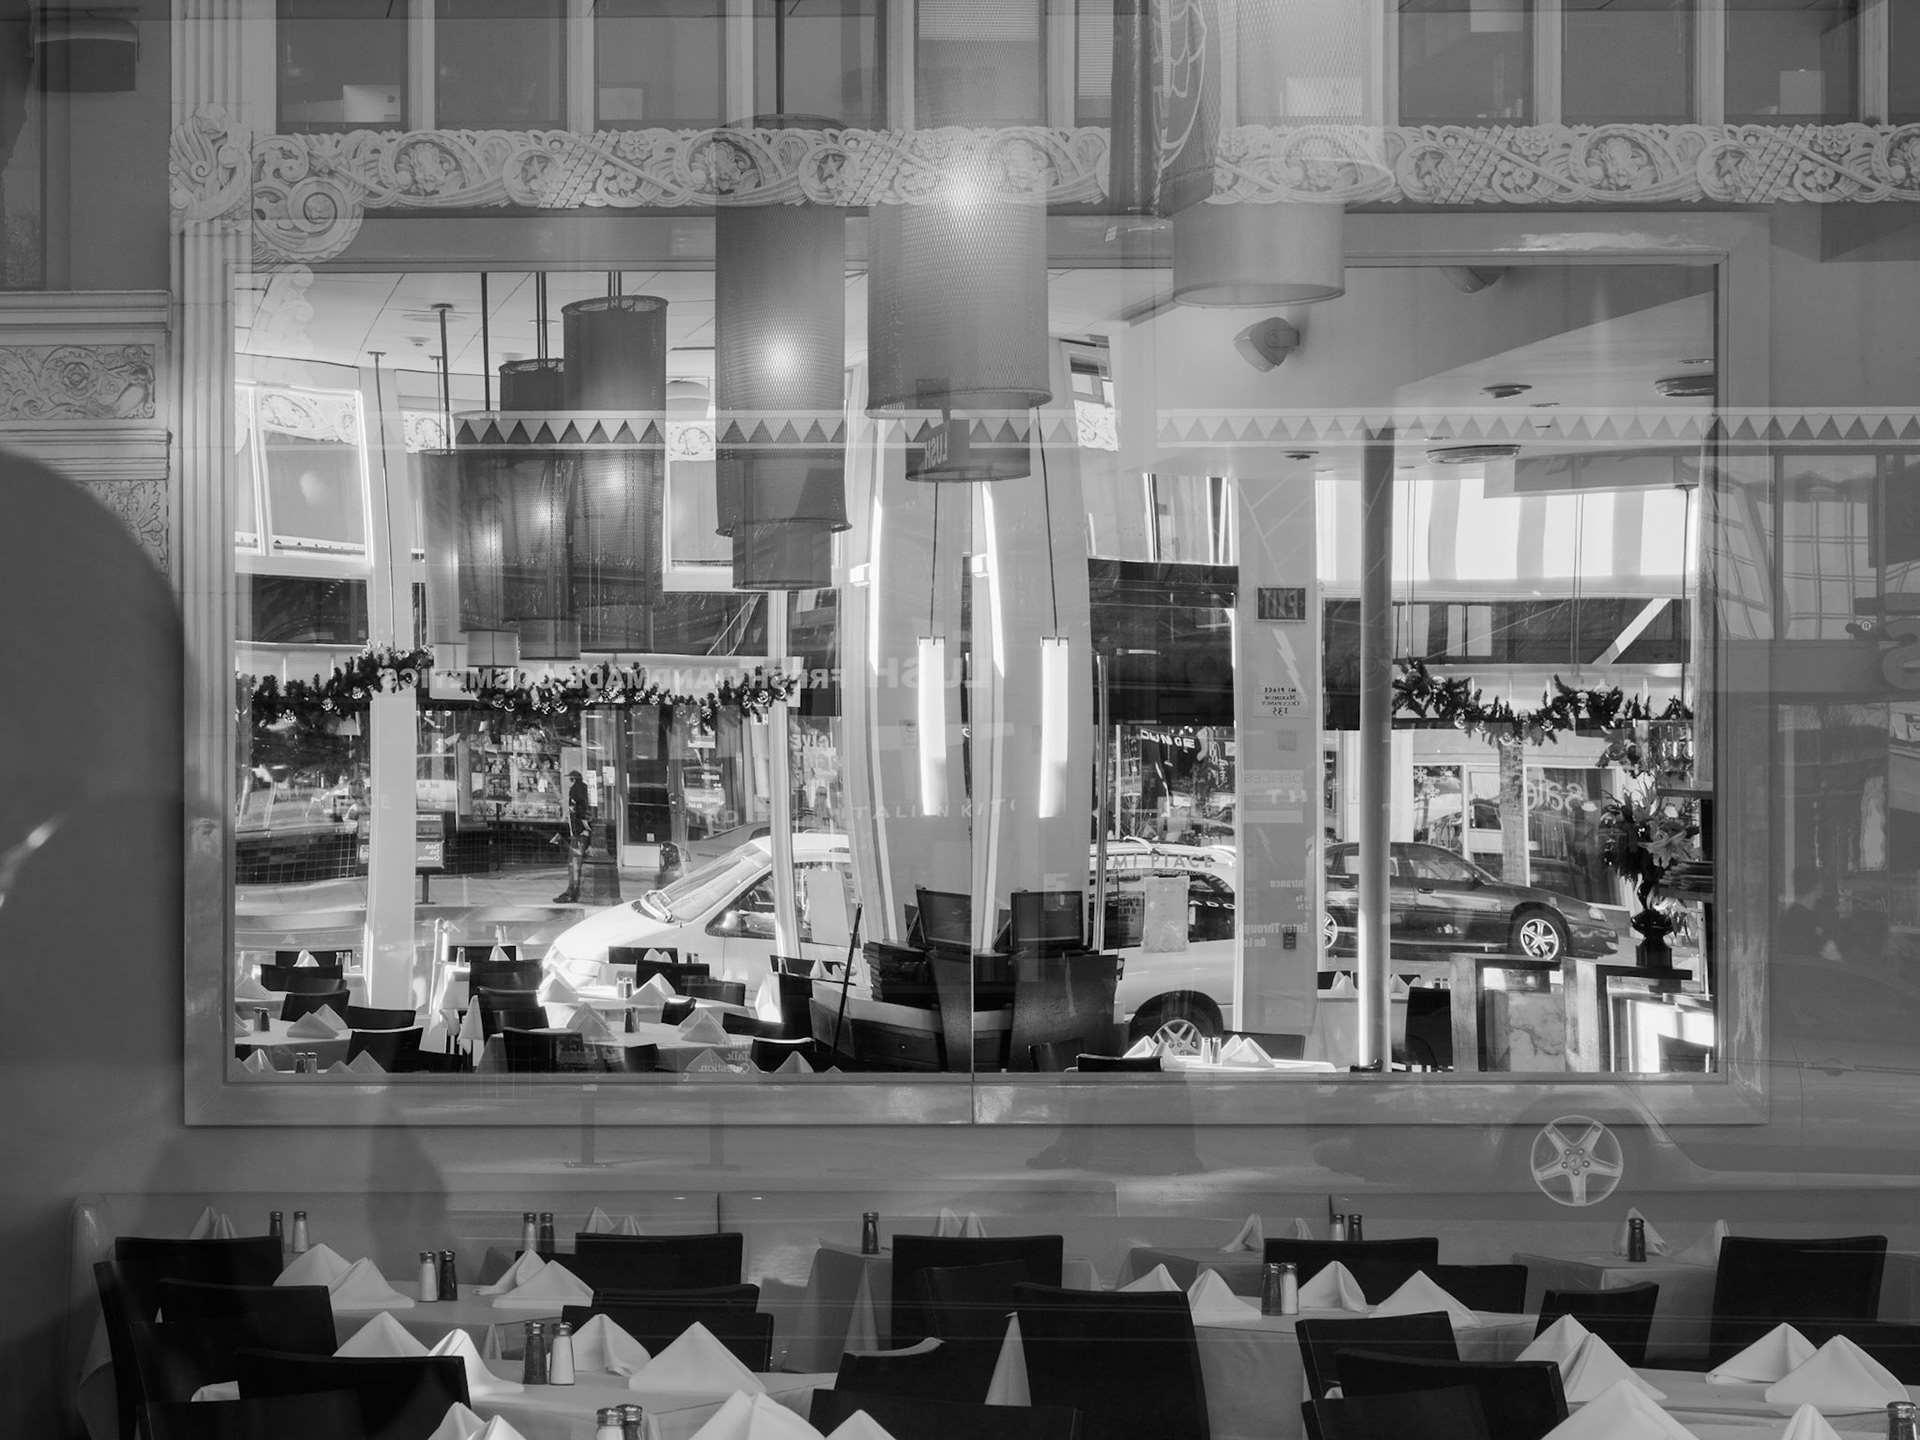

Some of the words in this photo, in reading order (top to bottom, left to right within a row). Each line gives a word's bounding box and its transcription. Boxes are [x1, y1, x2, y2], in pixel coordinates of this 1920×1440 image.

[840, 805, 949, 820] ITALIN
[1112, 855, 1138, 868] MI
[1151, 854, 1213, 868] PIACE
